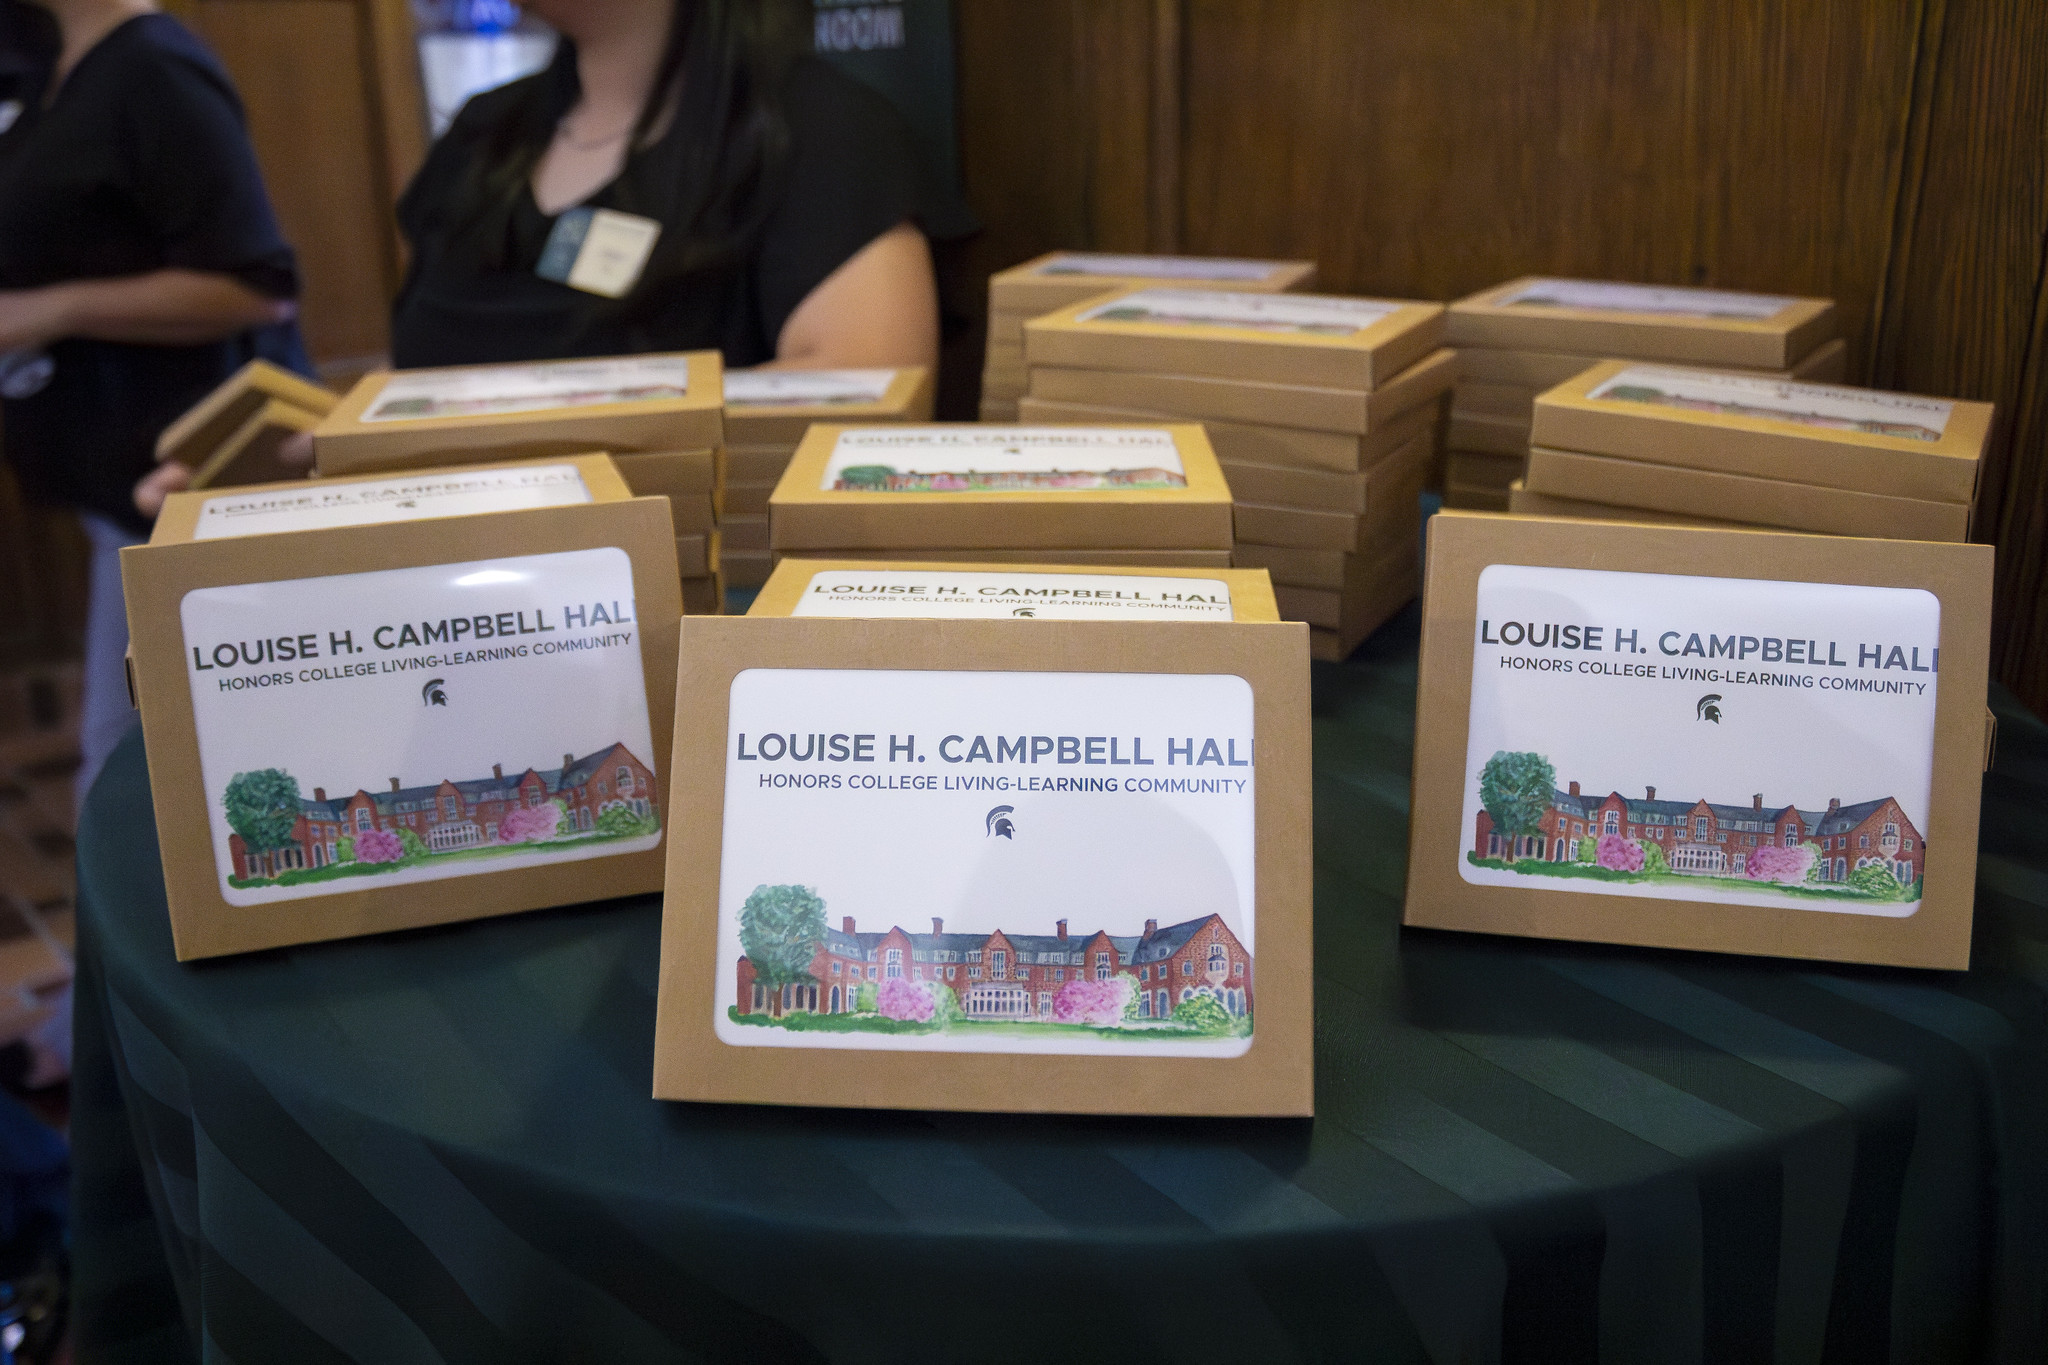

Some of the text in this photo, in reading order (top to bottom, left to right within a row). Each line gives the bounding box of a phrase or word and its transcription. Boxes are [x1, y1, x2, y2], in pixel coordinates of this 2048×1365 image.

[814, 585, 1232, 605] LOUISE H. CAMPBELL HAL
[980, 597, 1121, 607] LIVING-LEARNING
[1126, 601, 1226, 612] COMMUNITY
[193, 600, 637, 671] LOUISE H. CAMPBELL HAL
[1481, 620, 1604, 651] LOUISE
[1614, 628, 1647, 654] H.
[1658, 631, 1847, 667] CAMPBELL
[219, 633, 632, 692] HONORS COLLEGE LIVING-LEARNING COMMUNITY
[1500, 656, 1927, 696] HONORS COLLEGE LIVING-LEARNING COMMUNITY
[737, 733, 1255, 767] LOUISE H. CAMPBELL HAL
[759, 773, 1246, 794] HONORS COLLEGE LIVING-LEARNING COMMUNITY
